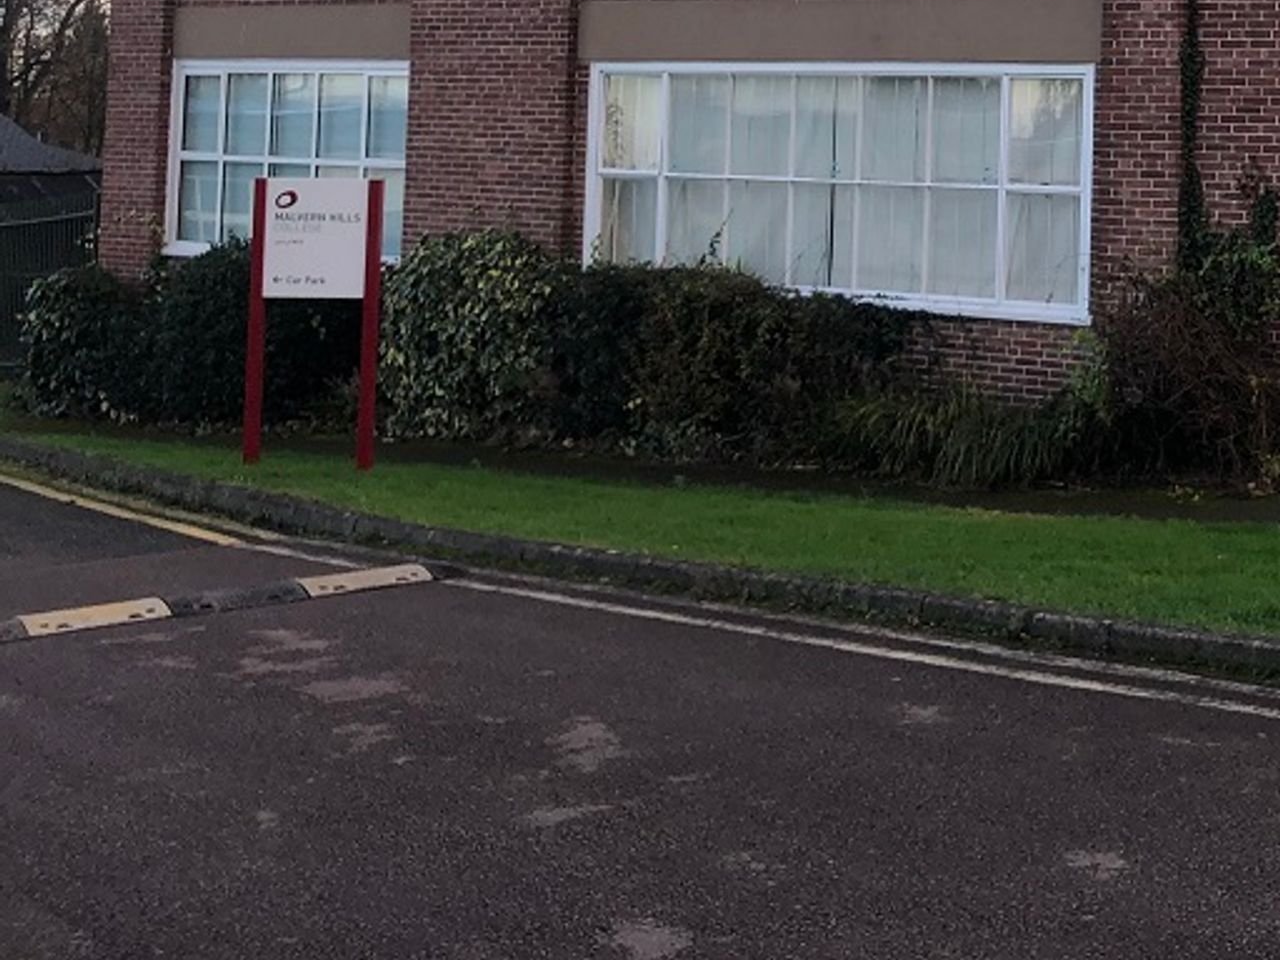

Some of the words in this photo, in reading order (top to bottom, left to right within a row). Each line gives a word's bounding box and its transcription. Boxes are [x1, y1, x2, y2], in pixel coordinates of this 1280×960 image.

[274, 212, 326, 222] MALVERN
[285, 275, 302, 285] Car
[305, 275, 326, 285] Park
